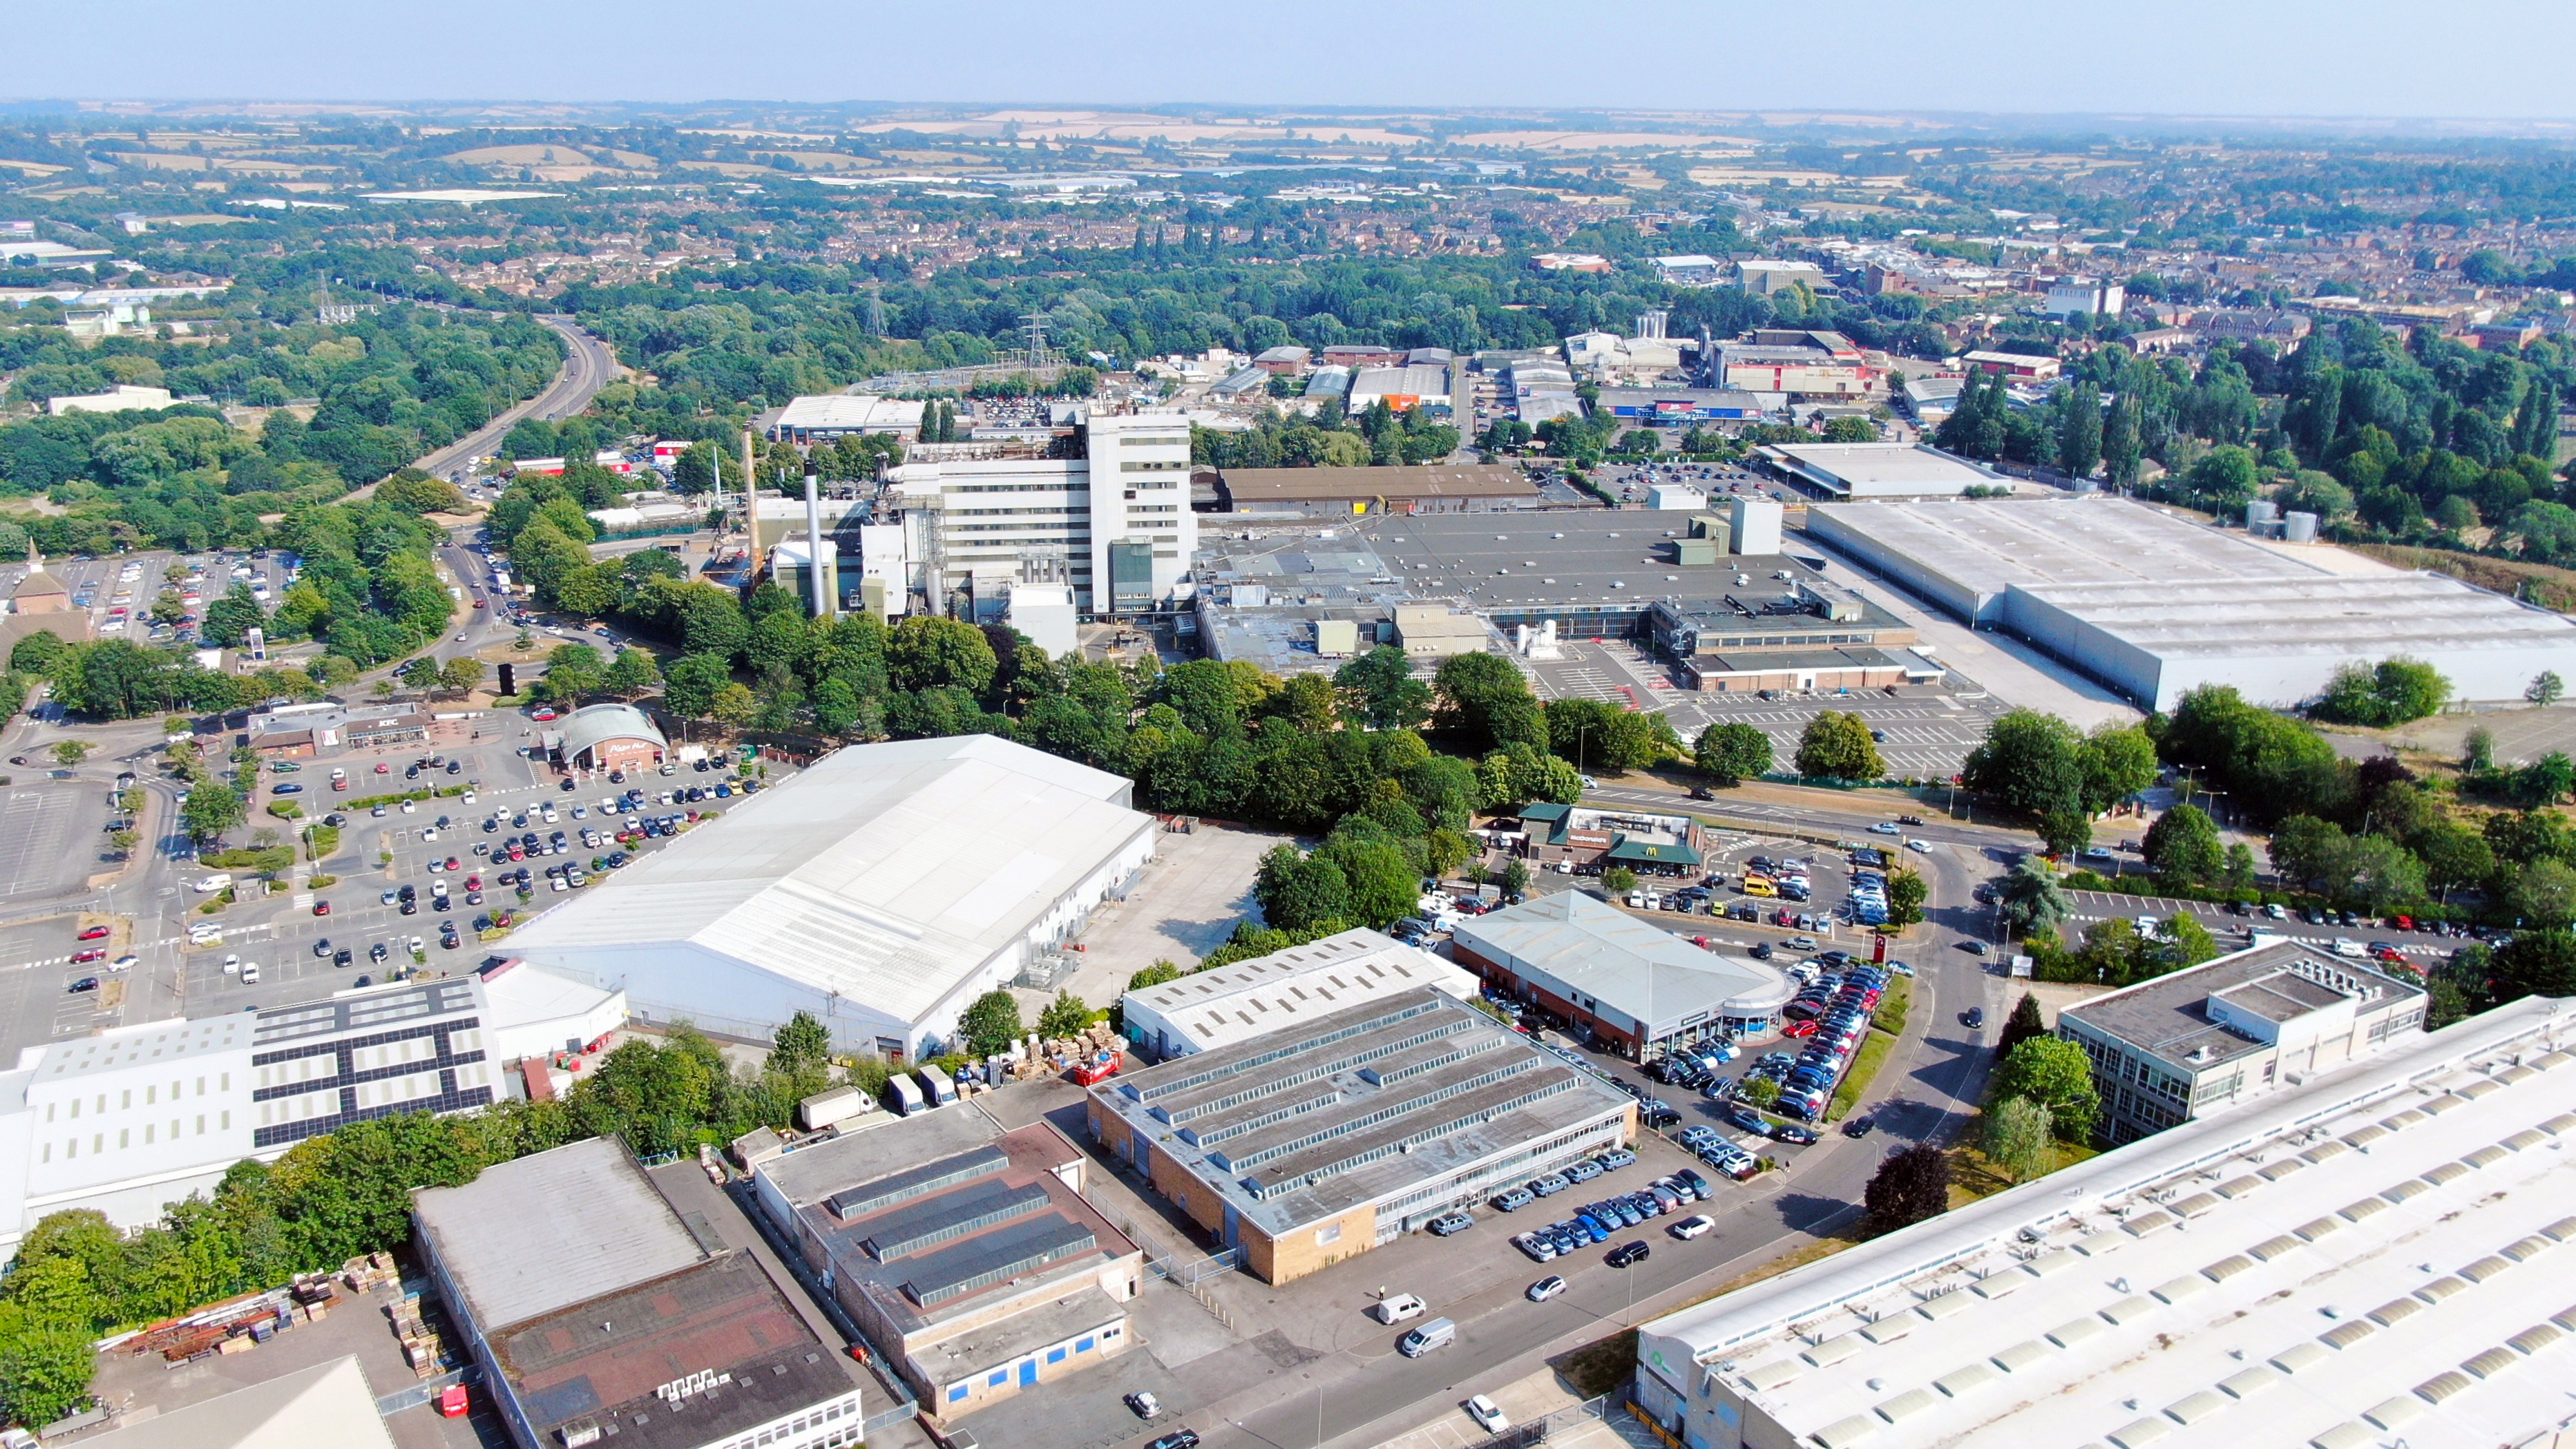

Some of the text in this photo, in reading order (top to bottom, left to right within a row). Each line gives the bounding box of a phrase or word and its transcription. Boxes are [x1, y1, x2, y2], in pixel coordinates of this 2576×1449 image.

[379, 718, 399, 727] KFC
[609, 745, 631, 753] Pizza
[1570, 834, 1607, 843] McDonald's
